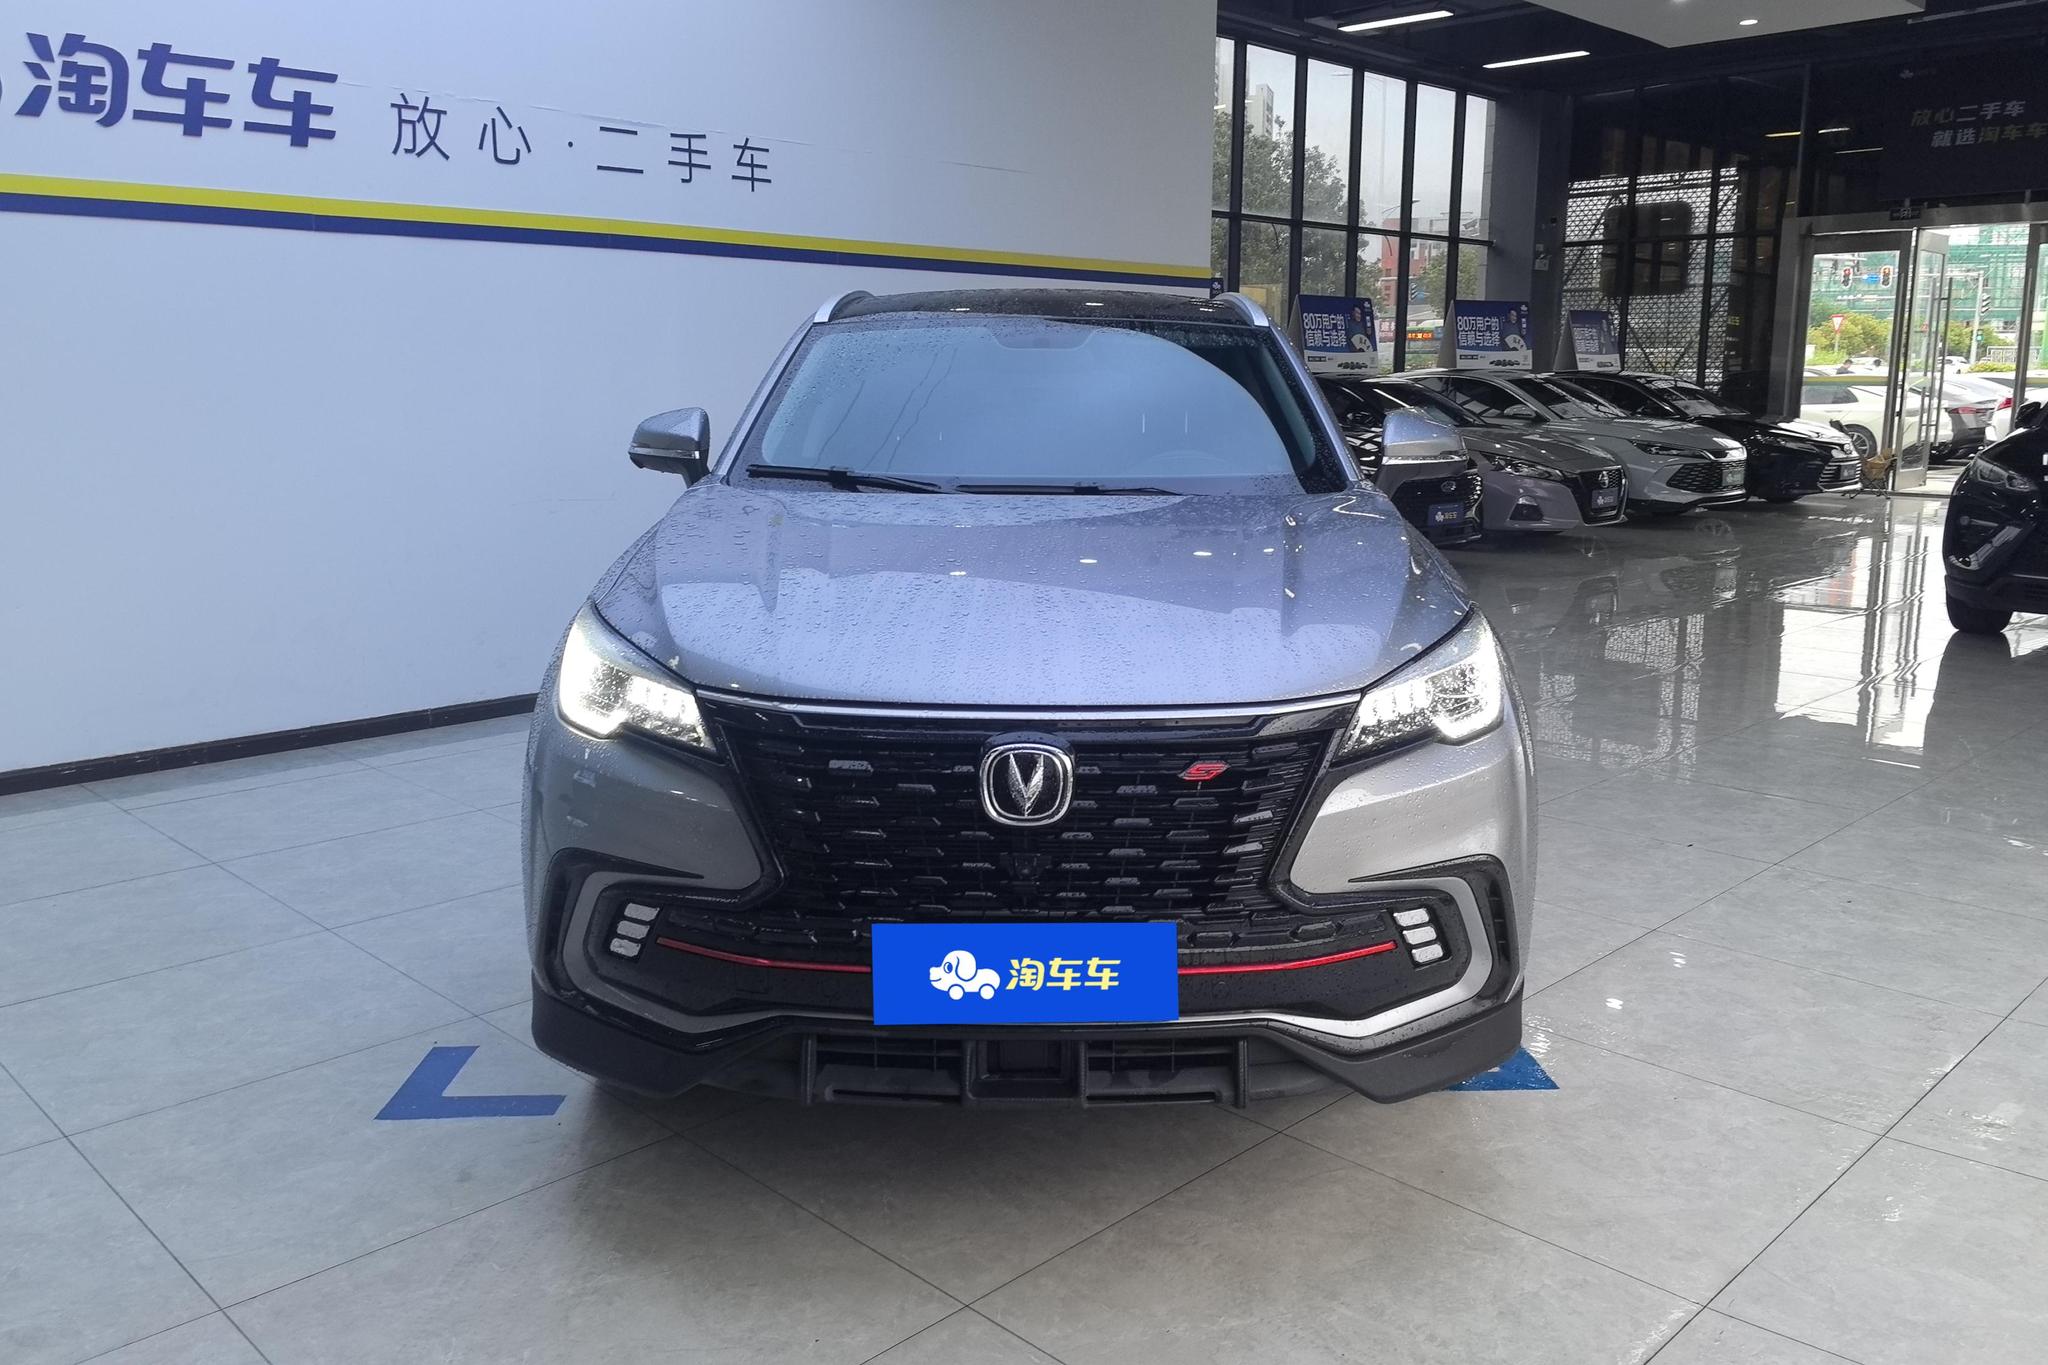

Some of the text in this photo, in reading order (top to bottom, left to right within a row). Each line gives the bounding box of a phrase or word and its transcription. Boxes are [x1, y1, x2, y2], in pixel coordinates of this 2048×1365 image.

[15, 32, 339, 147] 淘车车
[1302, 312, 1345, 330] 80万用户的
[1457, 316, 1499, 331] 80万用户的
